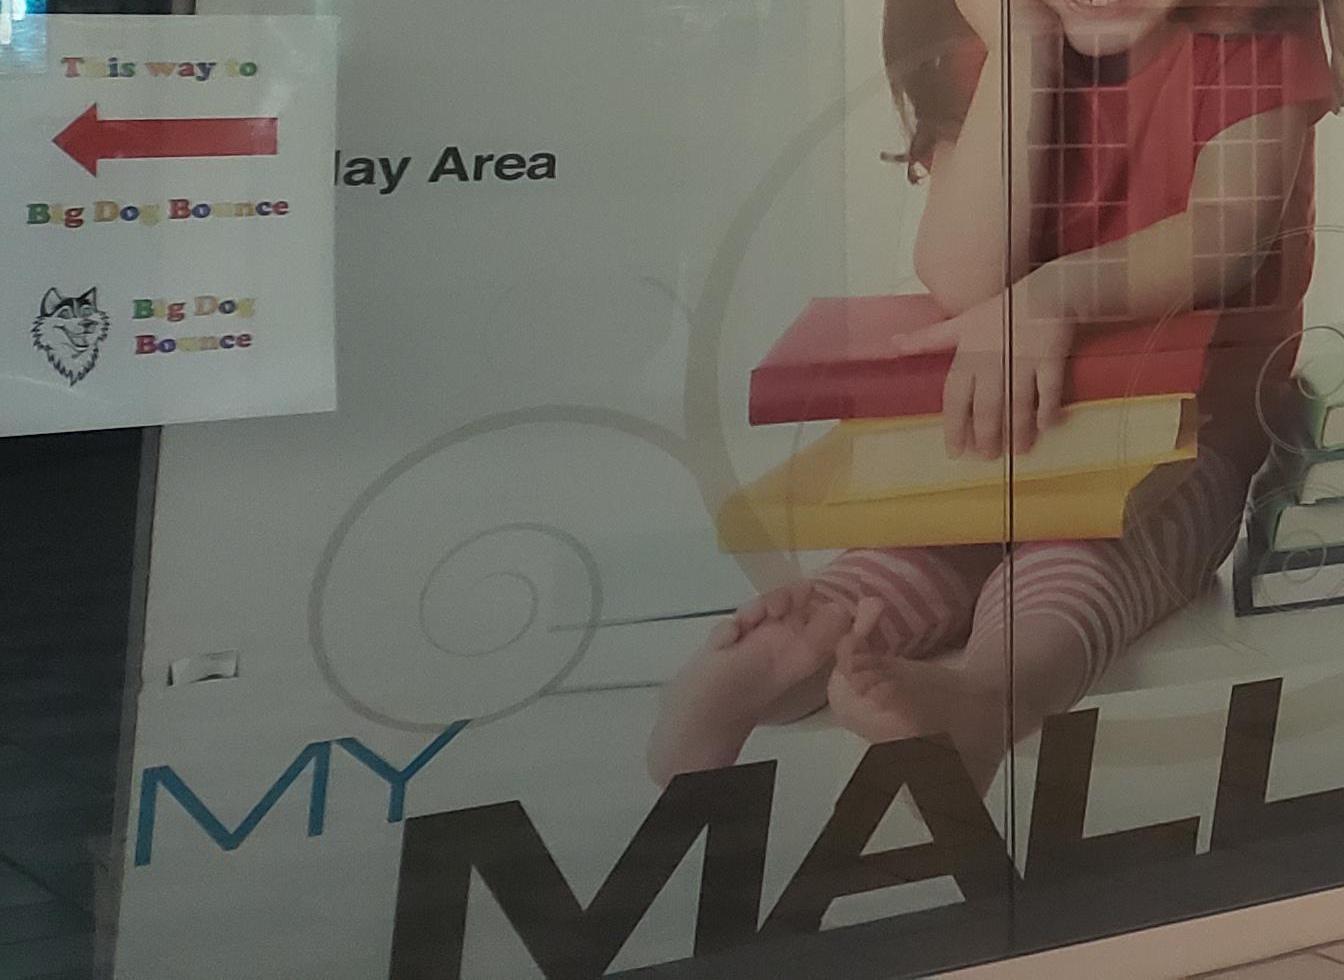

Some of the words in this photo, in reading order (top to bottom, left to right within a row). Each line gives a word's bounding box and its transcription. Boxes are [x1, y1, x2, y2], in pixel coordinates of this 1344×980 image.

[60, 57, 136, 78] This
[145, 62, 217, 81] way
[227, 58, 258, 77] to
[335, 149, 412, 195] lay
[428, 146, 557, 182] Area
[26, 203, 84, 228] Big
[93, 200, 160, 226] Dog
[168, 198, 289, 220] Bounce
[132, 299, 187, 322] Big
[194, 295, 256, 318] Dog
[135, 333, 253, 355] Bounce
[135, 717, 473, 867] MY
